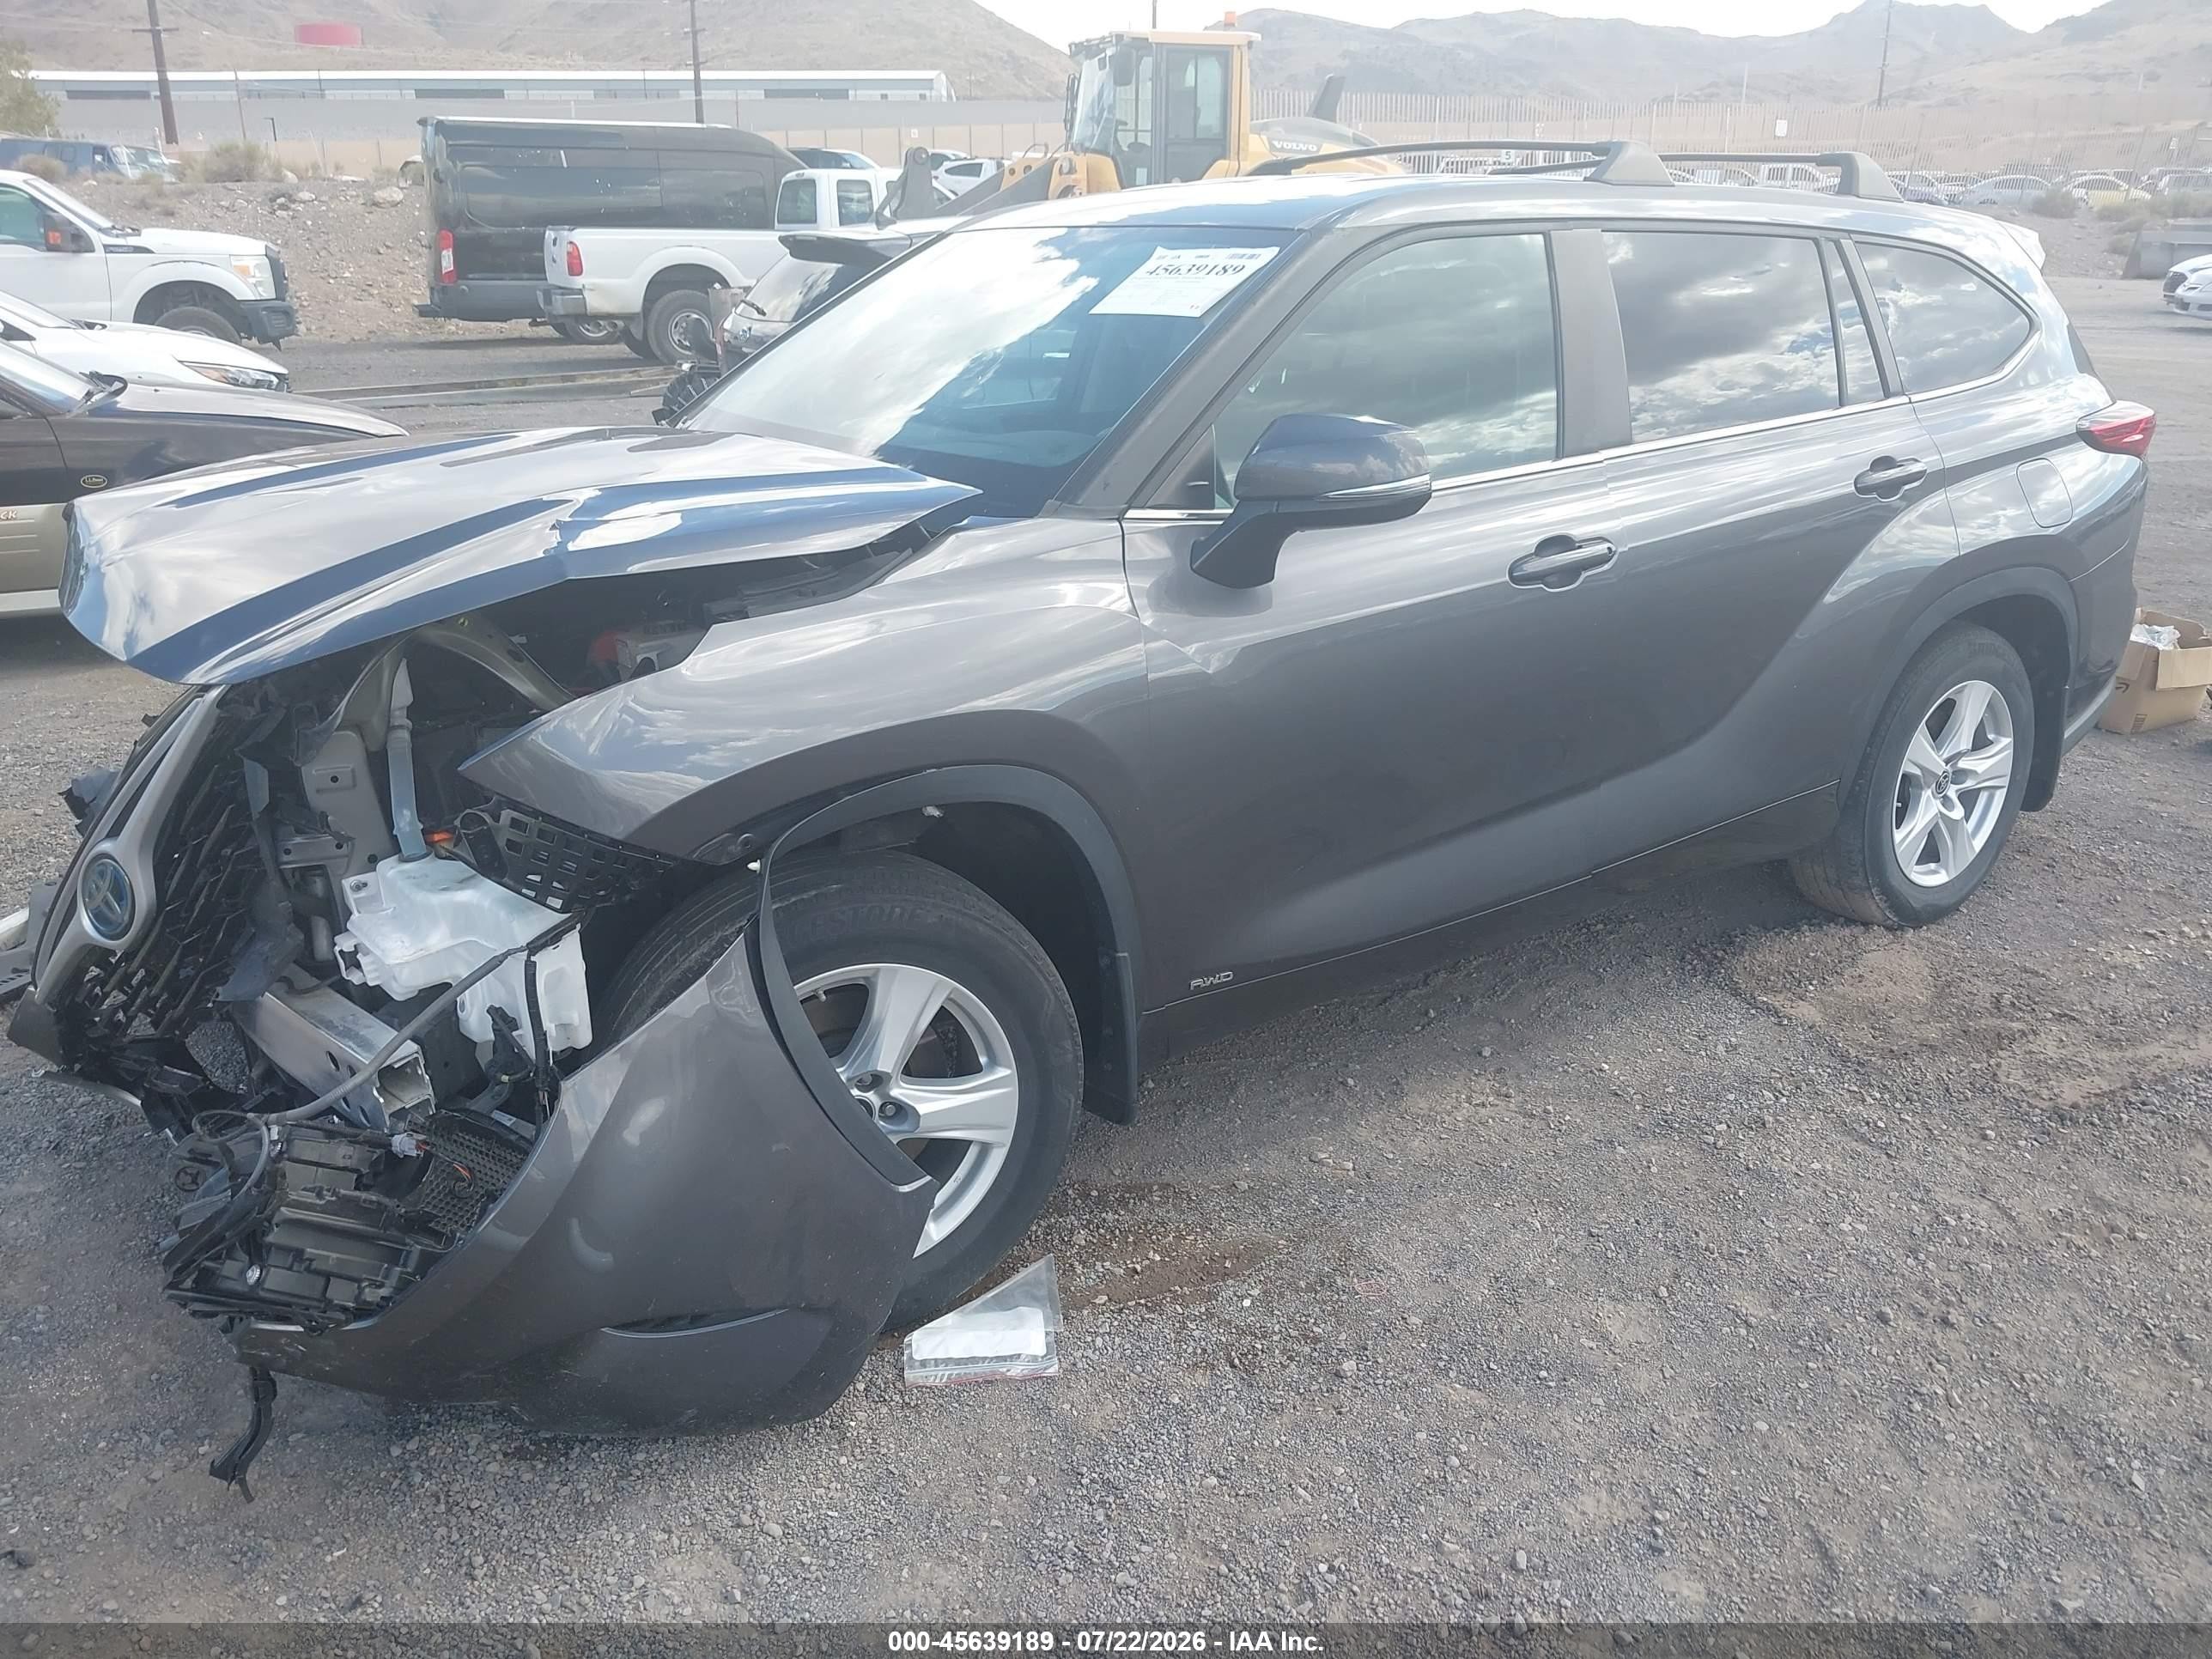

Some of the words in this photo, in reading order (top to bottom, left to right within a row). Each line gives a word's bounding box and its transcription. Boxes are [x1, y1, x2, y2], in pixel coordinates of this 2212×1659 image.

[1272, 141, 1317, 151] VOLVO
[1146, 264, 1246, 276] 45639189
[1190, 971, 1233, 990] AWD
